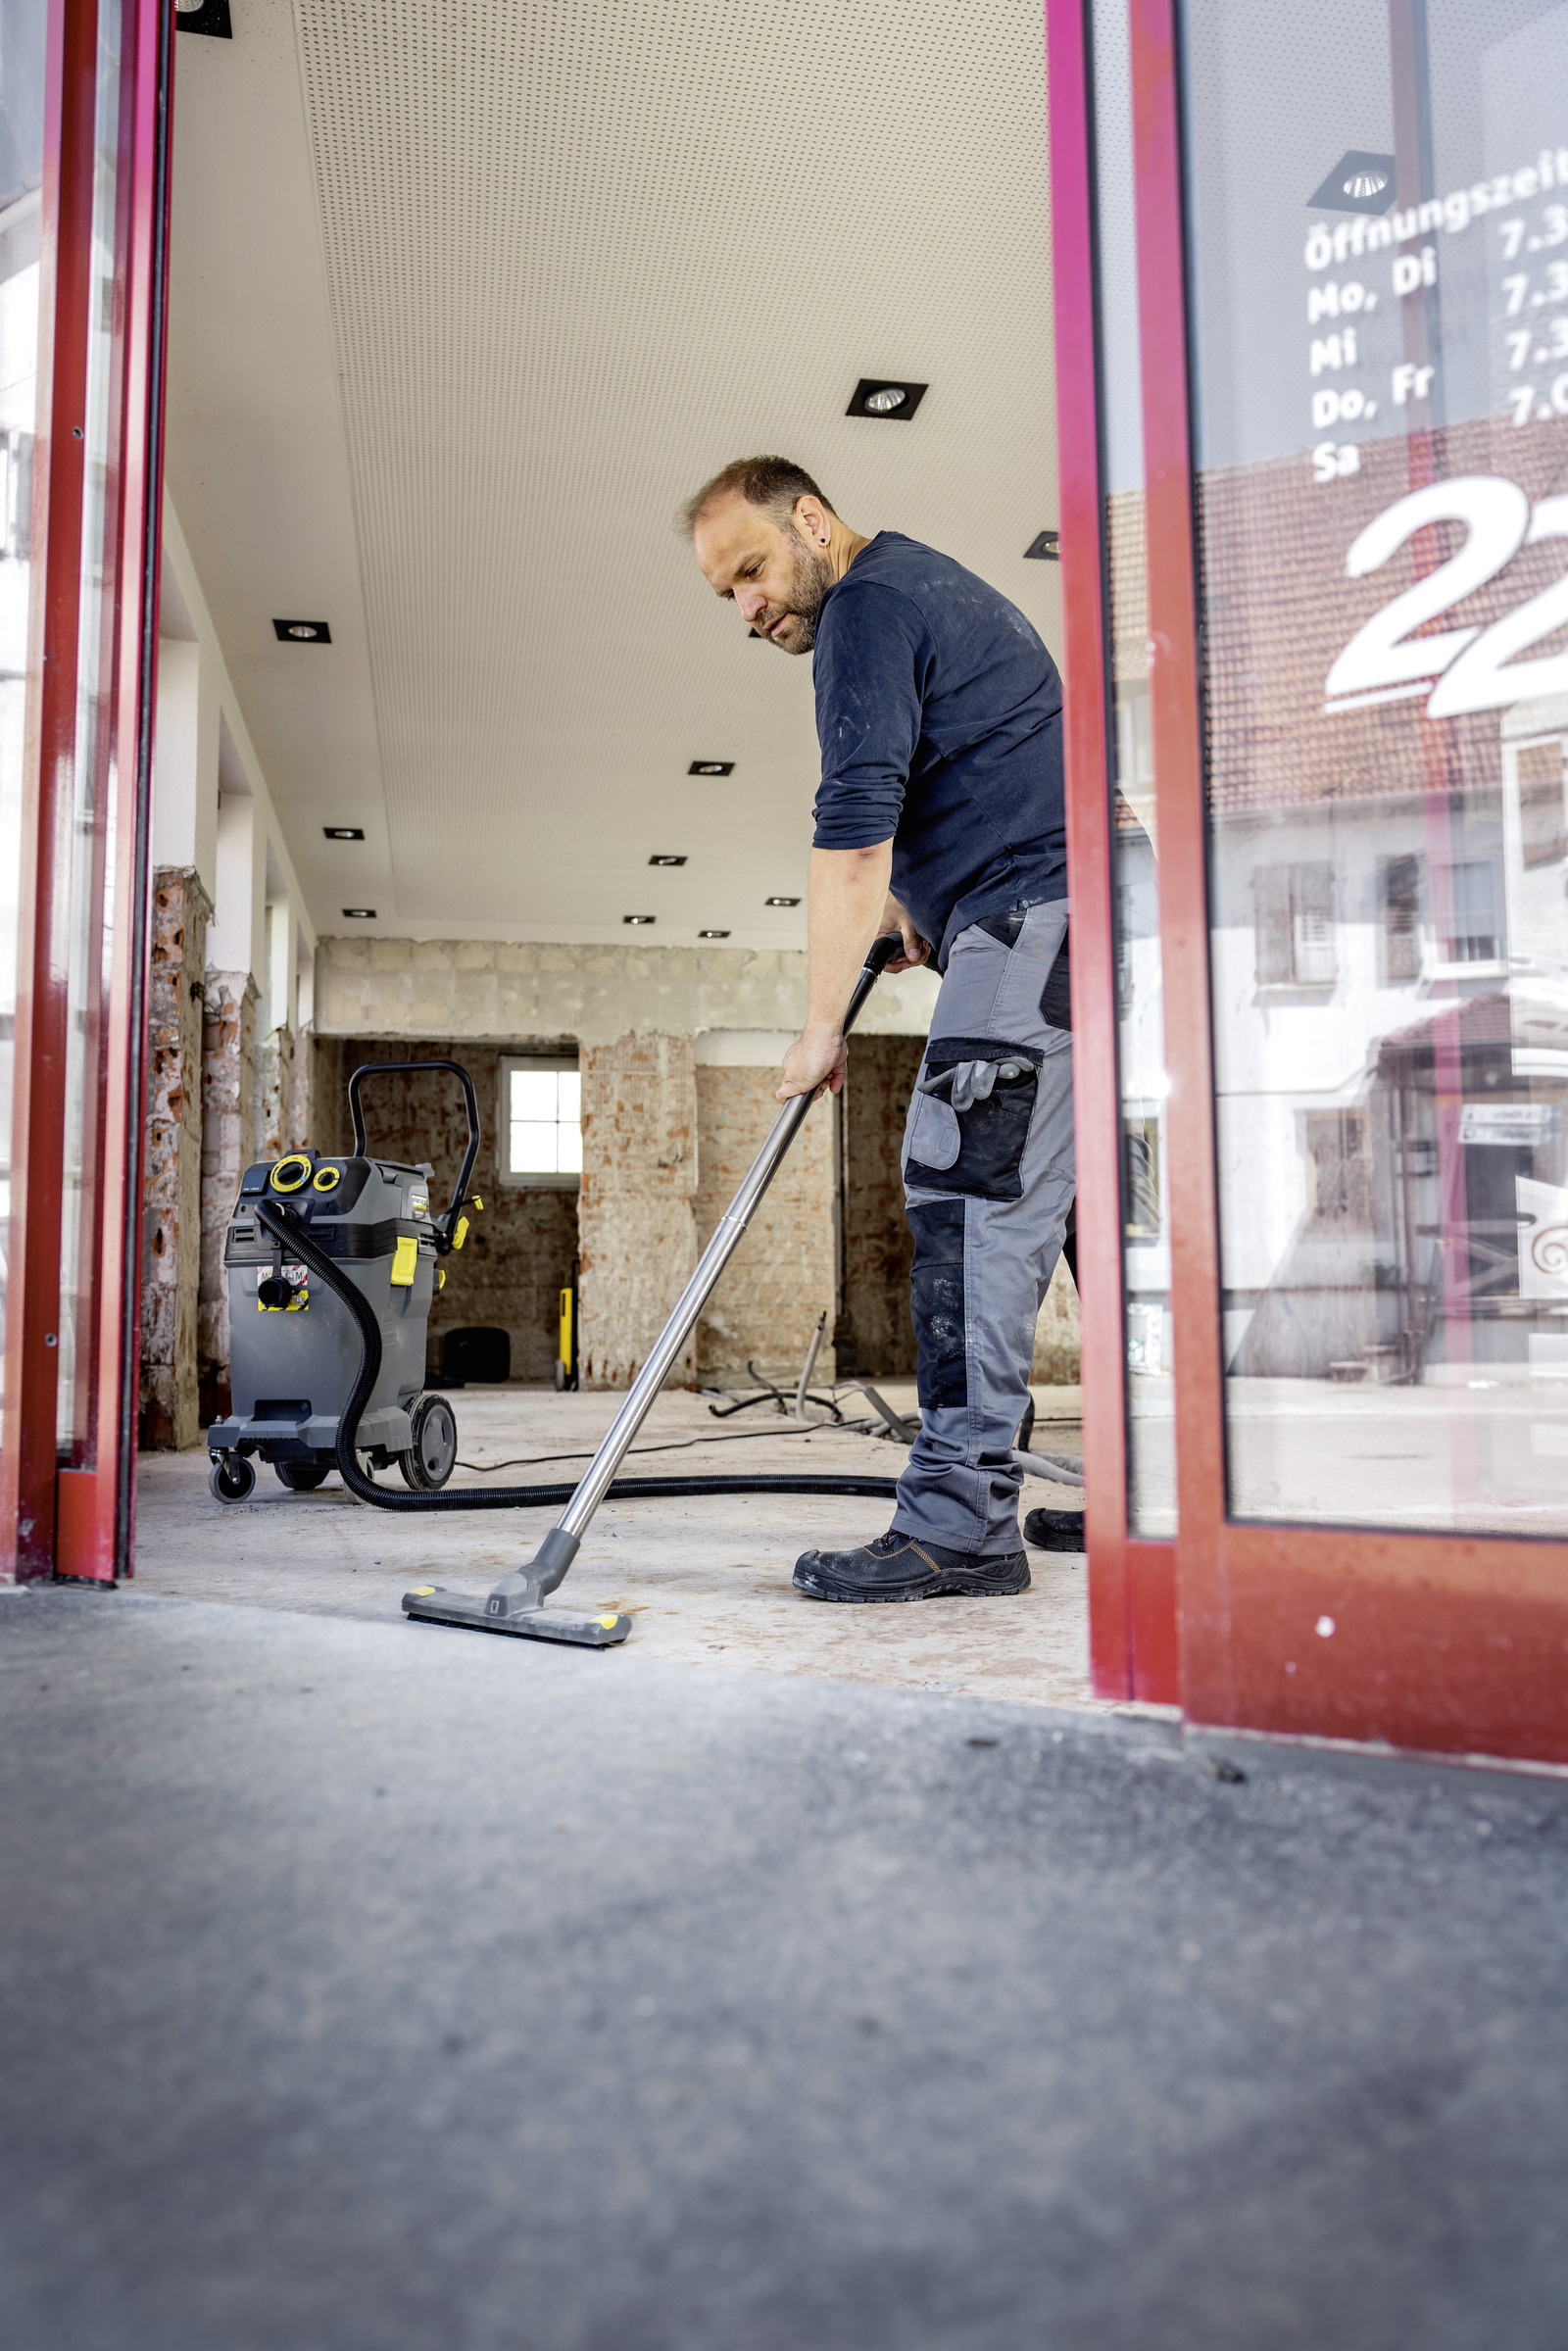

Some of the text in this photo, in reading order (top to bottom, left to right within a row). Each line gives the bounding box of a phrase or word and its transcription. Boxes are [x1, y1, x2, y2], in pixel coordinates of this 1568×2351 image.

[1392, 246, 1437, 295] Di
[1310, 326, 1357, 376] Mi
[1392, 363, 1435, 405] Fr
[1312, 441, 1360, 482] Sa
